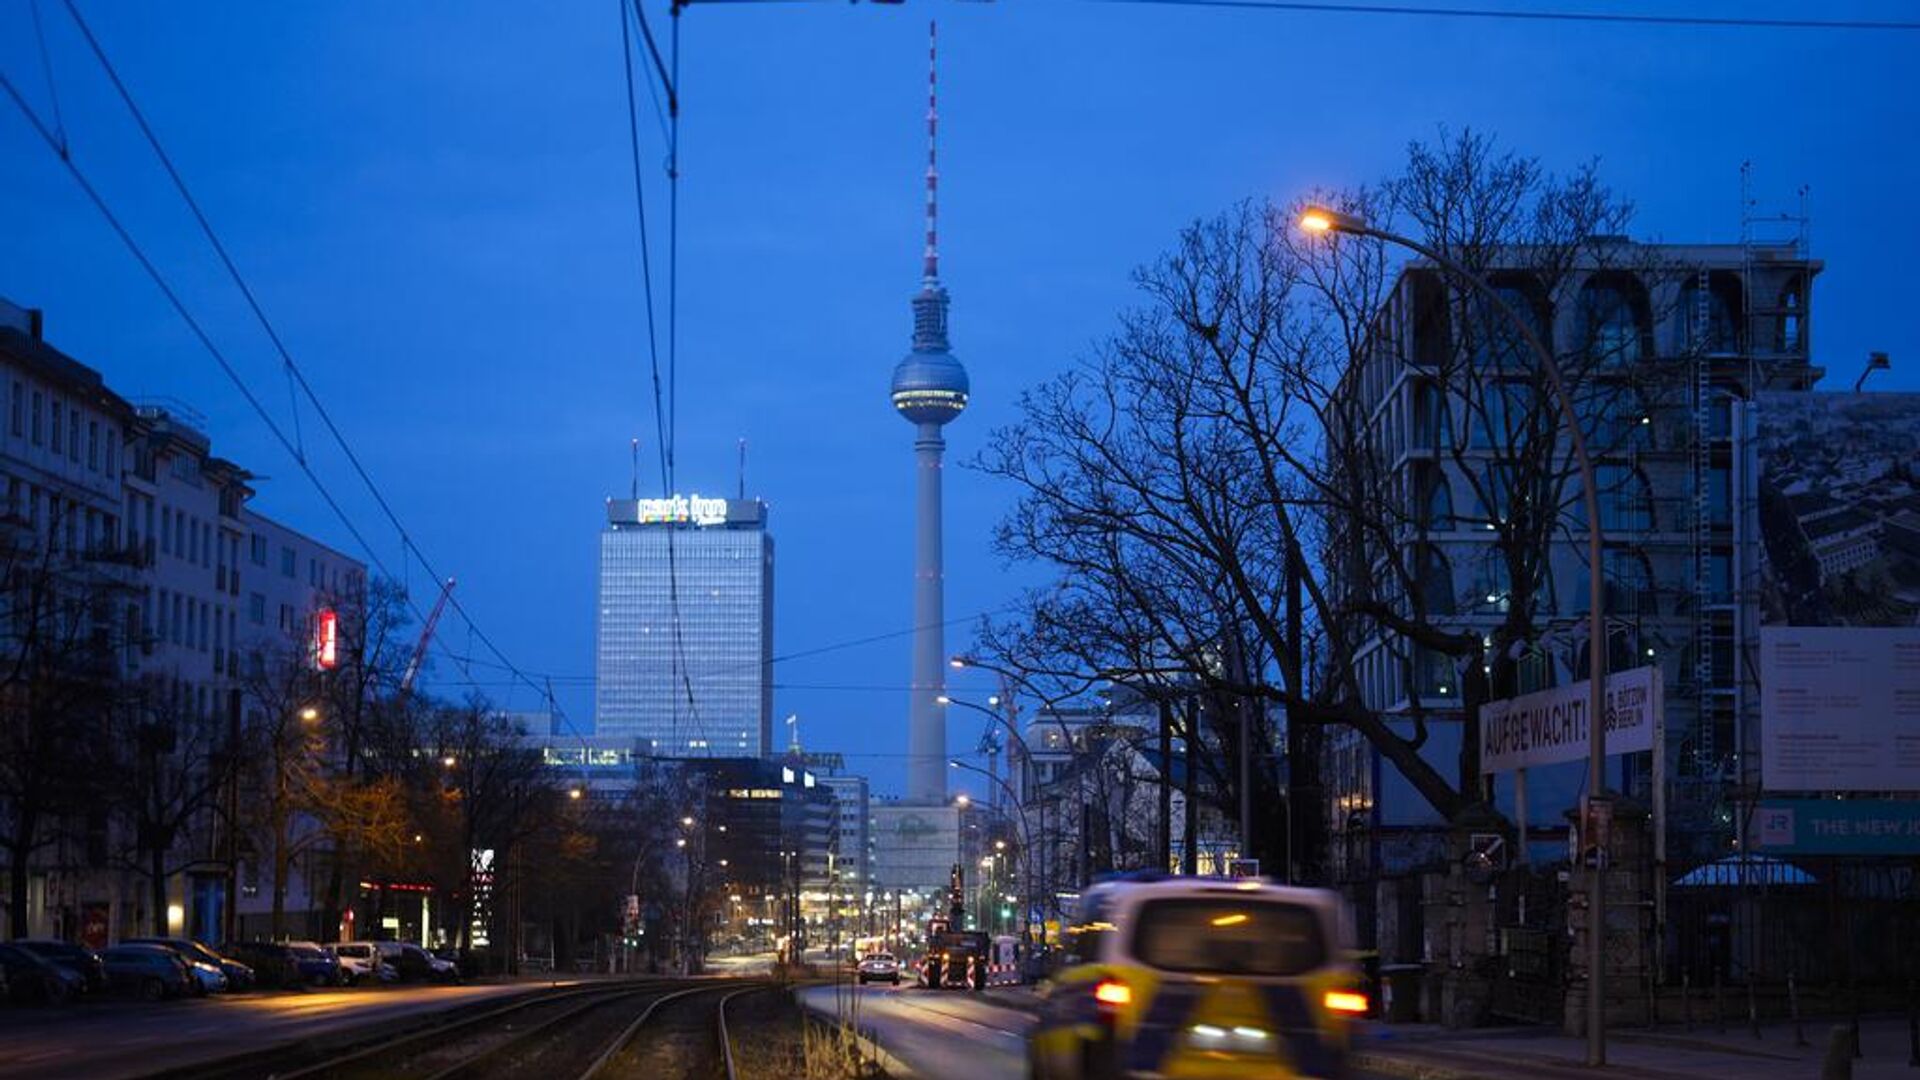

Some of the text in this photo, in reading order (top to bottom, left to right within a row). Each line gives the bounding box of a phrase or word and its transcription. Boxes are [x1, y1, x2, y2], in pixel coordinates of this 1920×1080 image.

[1485, 699, 1587, 756] AUFGEWACHT!
[1617, 707, 1644, 728] BERLIN
[1811, 818, 1849, 836] THE
[1856, 818, 1900, 836] NEW
